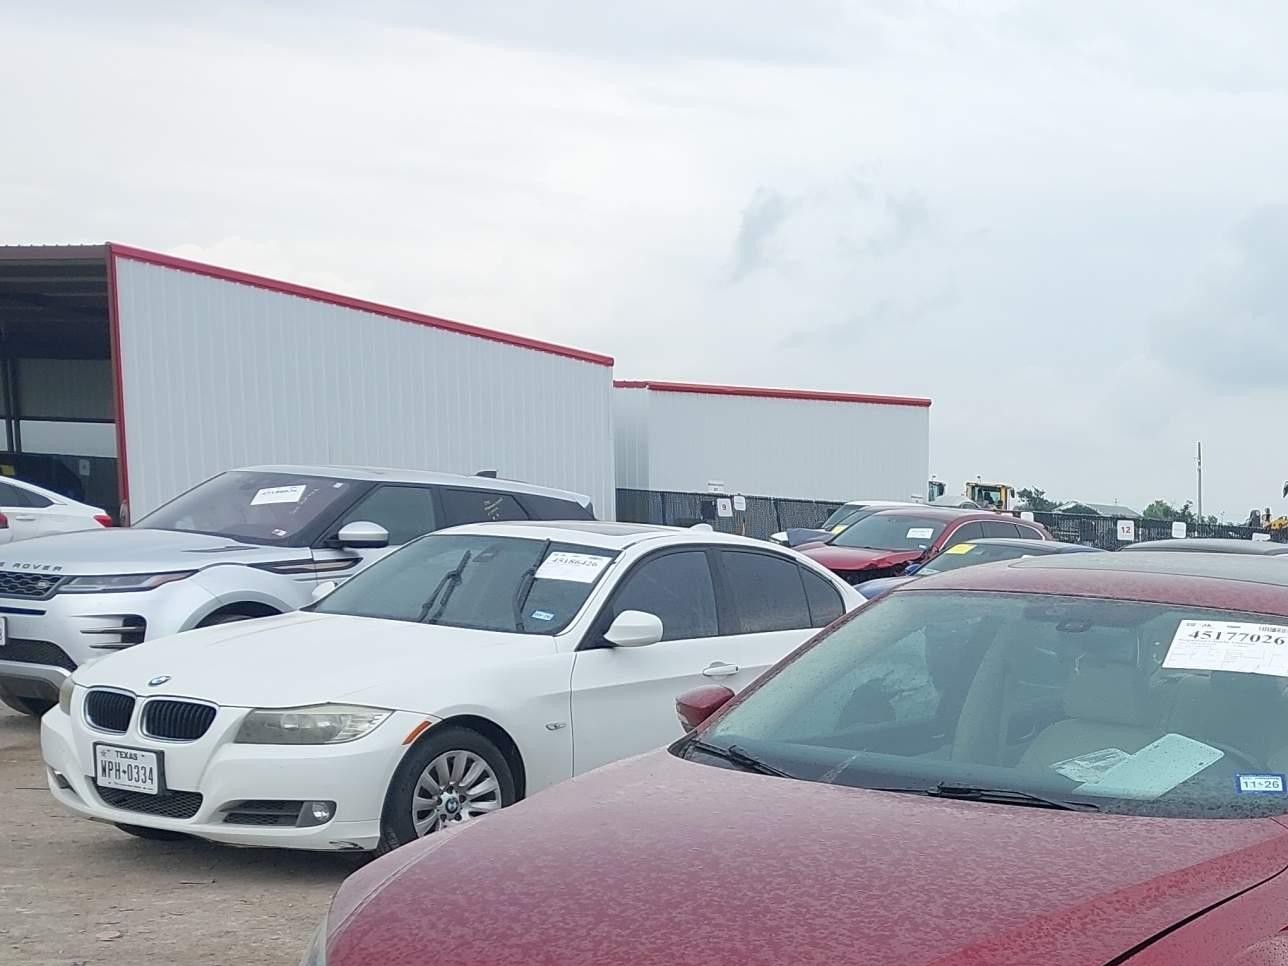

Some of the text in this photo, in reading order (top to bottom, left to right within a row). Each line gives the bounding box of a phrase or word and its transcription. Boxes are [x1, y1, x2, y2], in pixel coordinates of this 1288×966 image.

[1121, 526, 1131, 534] 12
[12, 561, 63, 571] ROVER
[1188, 630, 1286, 646] 45177026
[115, 750, 138, 760] TEXAS
